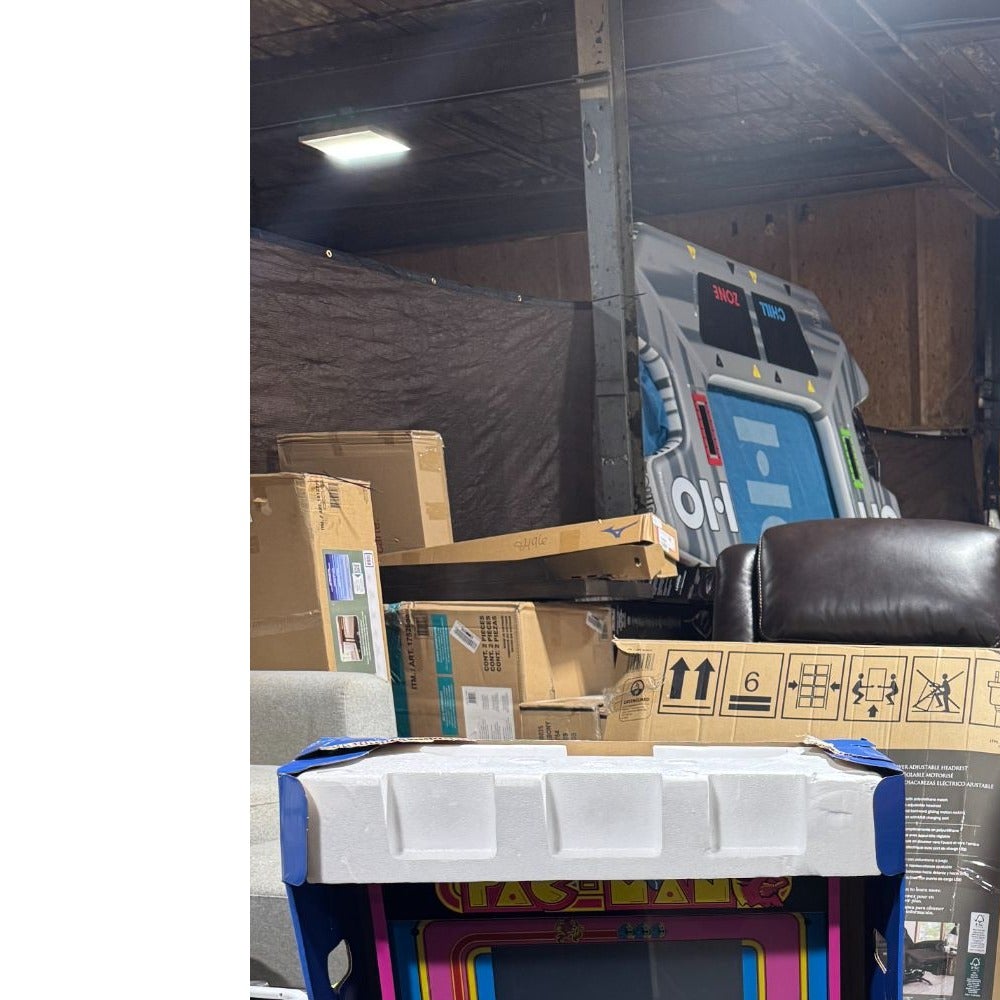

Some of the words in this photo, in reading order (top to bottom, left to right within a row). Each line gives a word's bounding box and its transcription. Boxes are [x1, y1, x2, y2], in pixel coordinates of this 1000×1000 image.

[711, 284, 741, 307] ZONE
[758, 301, 786, 322] CHILL
[744, 671, 760, 693] 6
